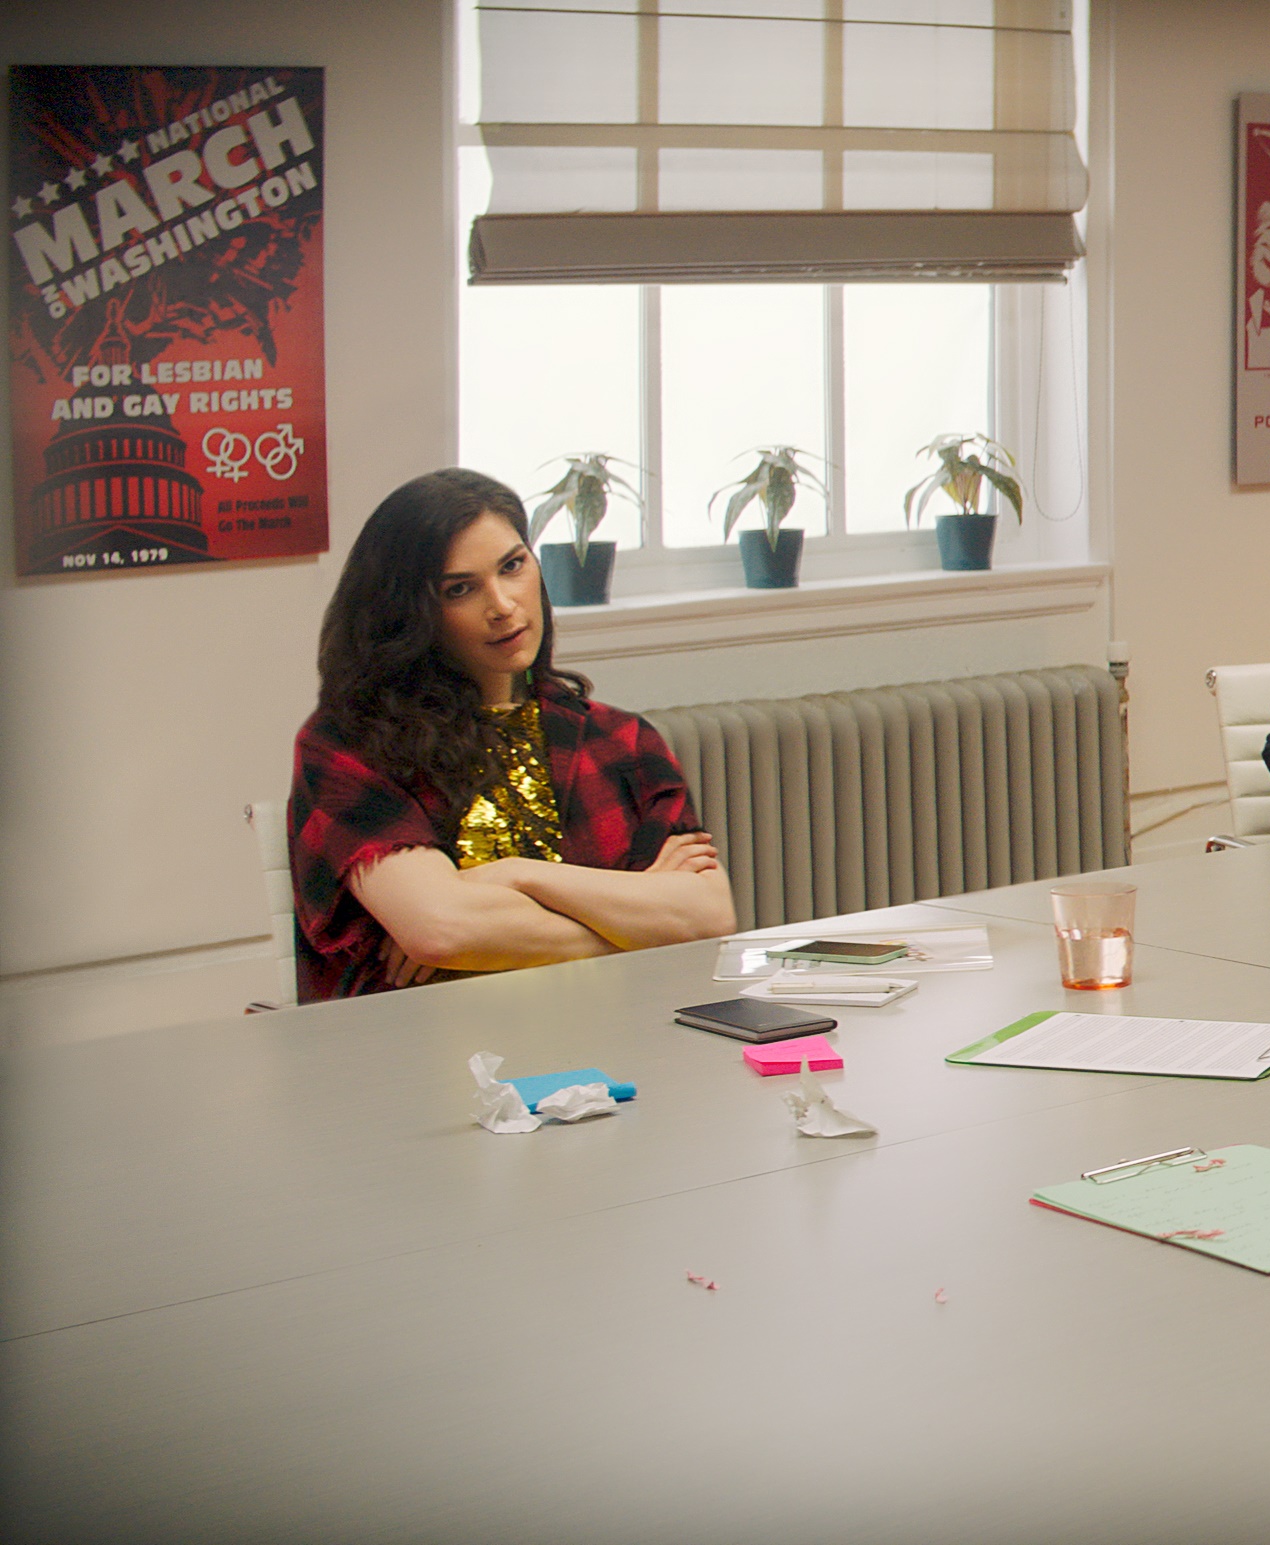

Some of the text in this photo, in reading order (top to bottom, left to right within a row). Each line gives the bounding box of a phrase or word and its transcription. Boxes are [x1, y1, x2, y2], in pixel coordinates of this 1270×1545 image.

[147, 76, 286, 155] NATIONAL
[14, 96, 316, 285] MARCH
[62, 162, 318, 308] WASHINGTON
[42, 284, 66, 320] ON
[72, 358, 263, 388] FOR LESBIAN
[51, 387, 294, 421] AND GAY RIGHTS
[236, 498, 285, 511] Proceeds
[62, 547, 169, 569] NOV 14, 1979
